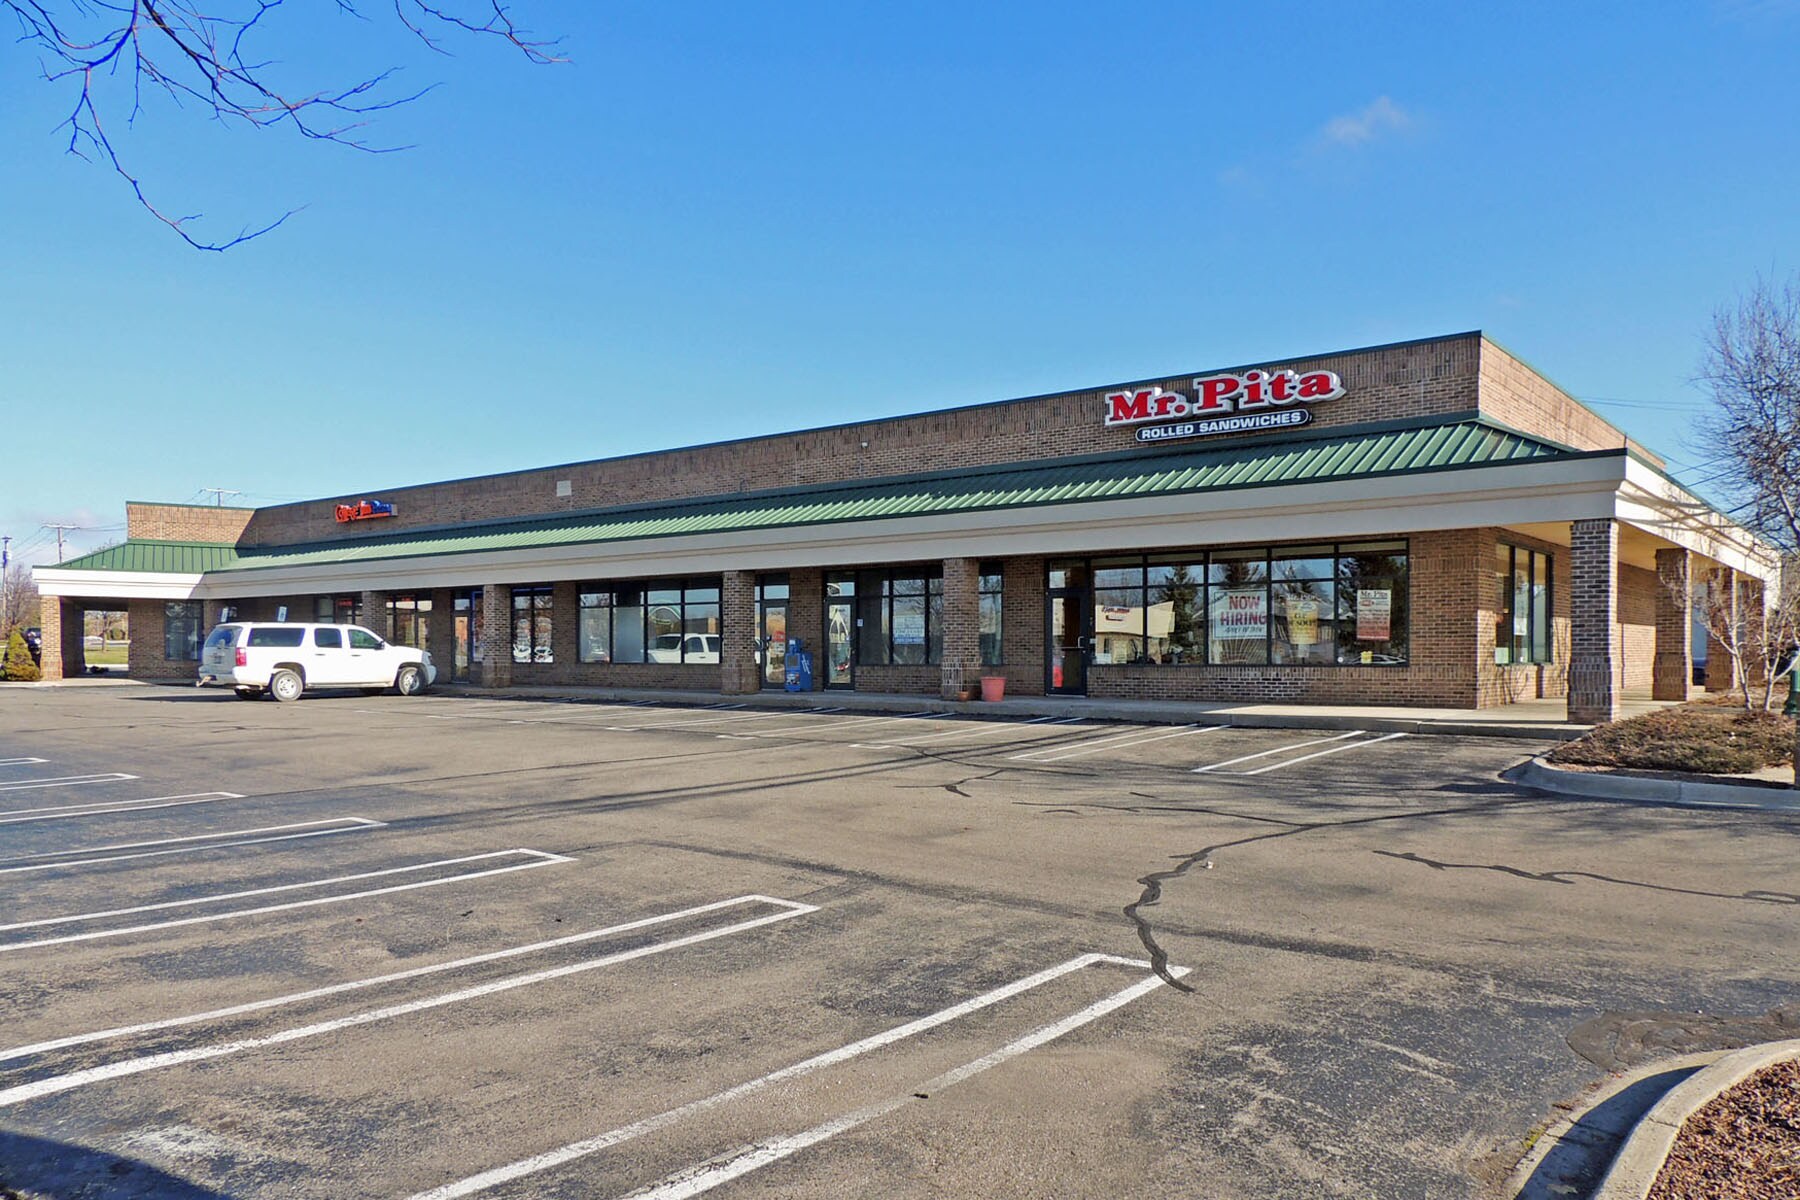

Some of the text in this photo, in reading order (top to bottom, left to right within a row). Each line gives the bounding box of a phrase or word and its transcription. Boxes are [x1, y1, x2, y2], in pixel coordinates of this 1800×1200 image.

[1106, 370, 1341, 423] Mr. Pita
[1141, 411, 1302, 440] ROLLED SANDWICHES
[1228, 595, 1261, 610] NOW
[1220, 611, 1267, 626] HIRING
